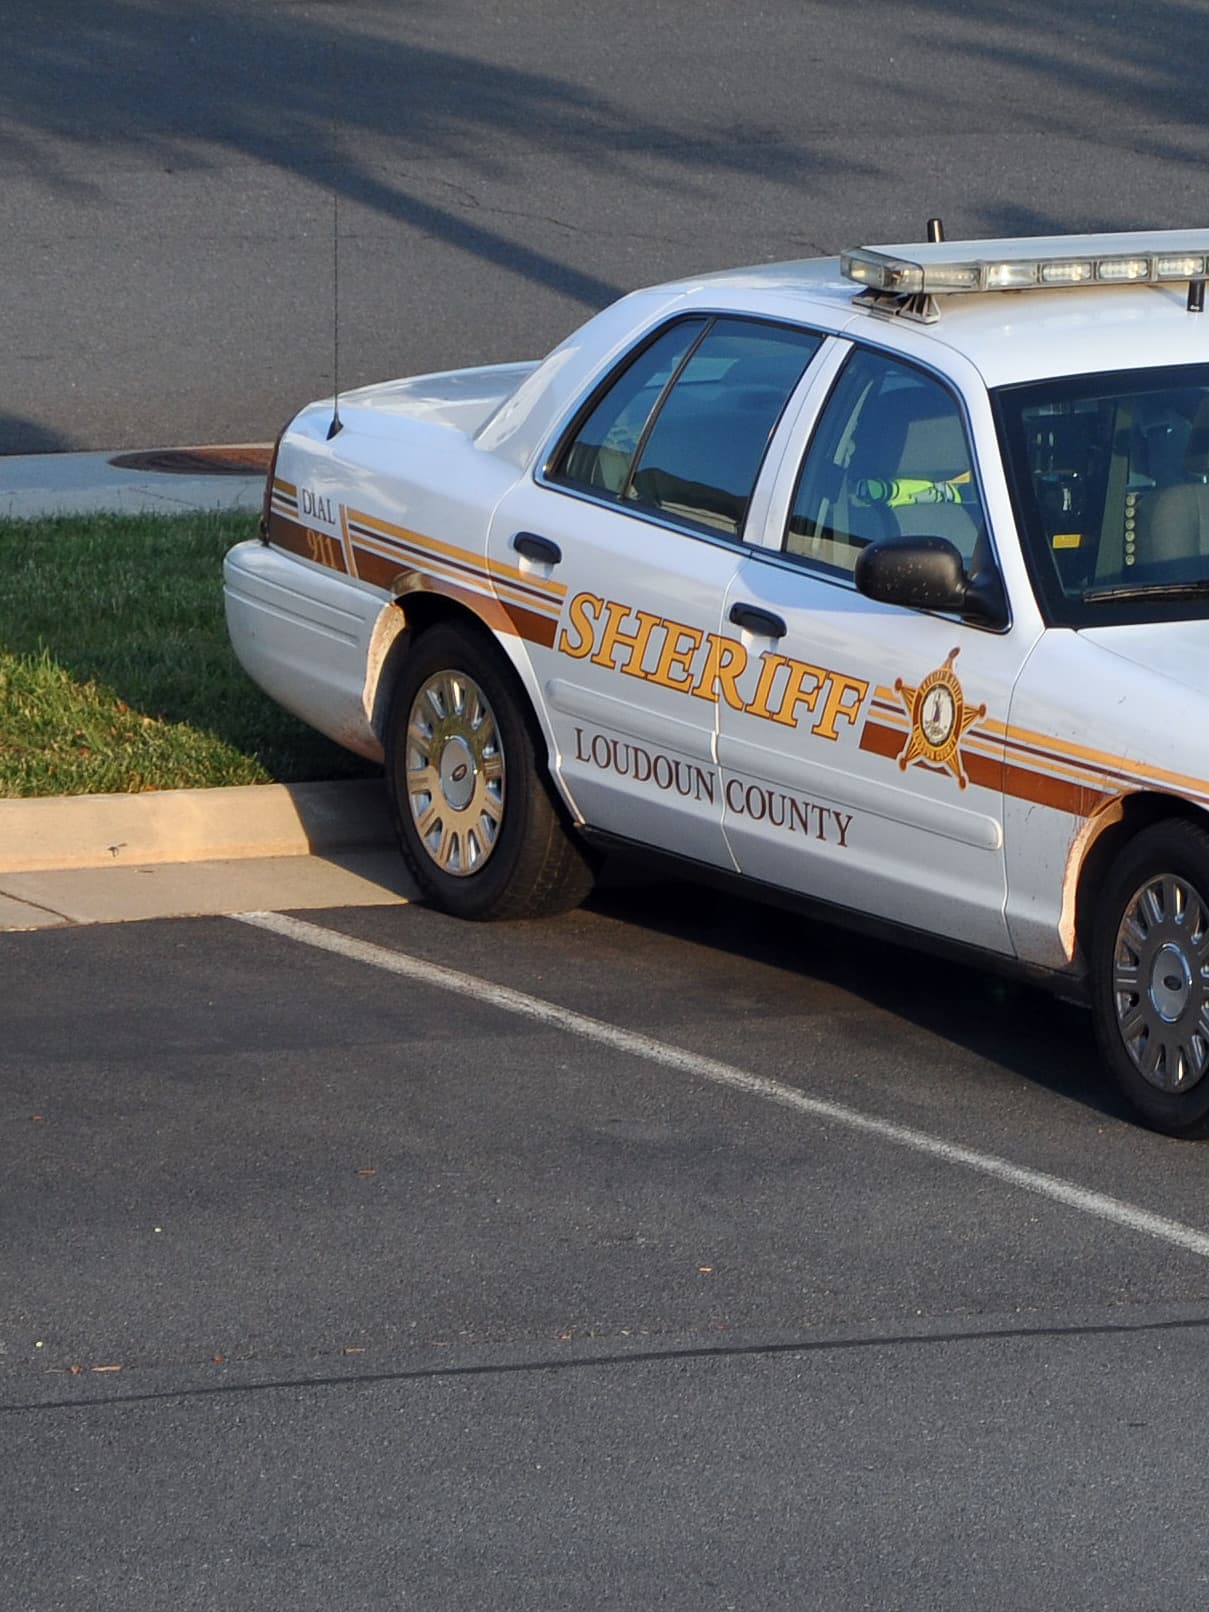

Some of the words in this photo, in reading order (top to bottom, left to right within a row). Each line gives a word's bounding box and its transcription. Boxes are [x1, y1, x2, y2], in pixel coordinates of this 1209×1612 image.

[302, 488, 336, 525] DIAL
[305, 528, 338, 570] 911
[558, 592, 870, 741] SHERIFF
[574, 727, 716, 805] LOUDOUN
[725, 779, 853, 848] COUNTY
